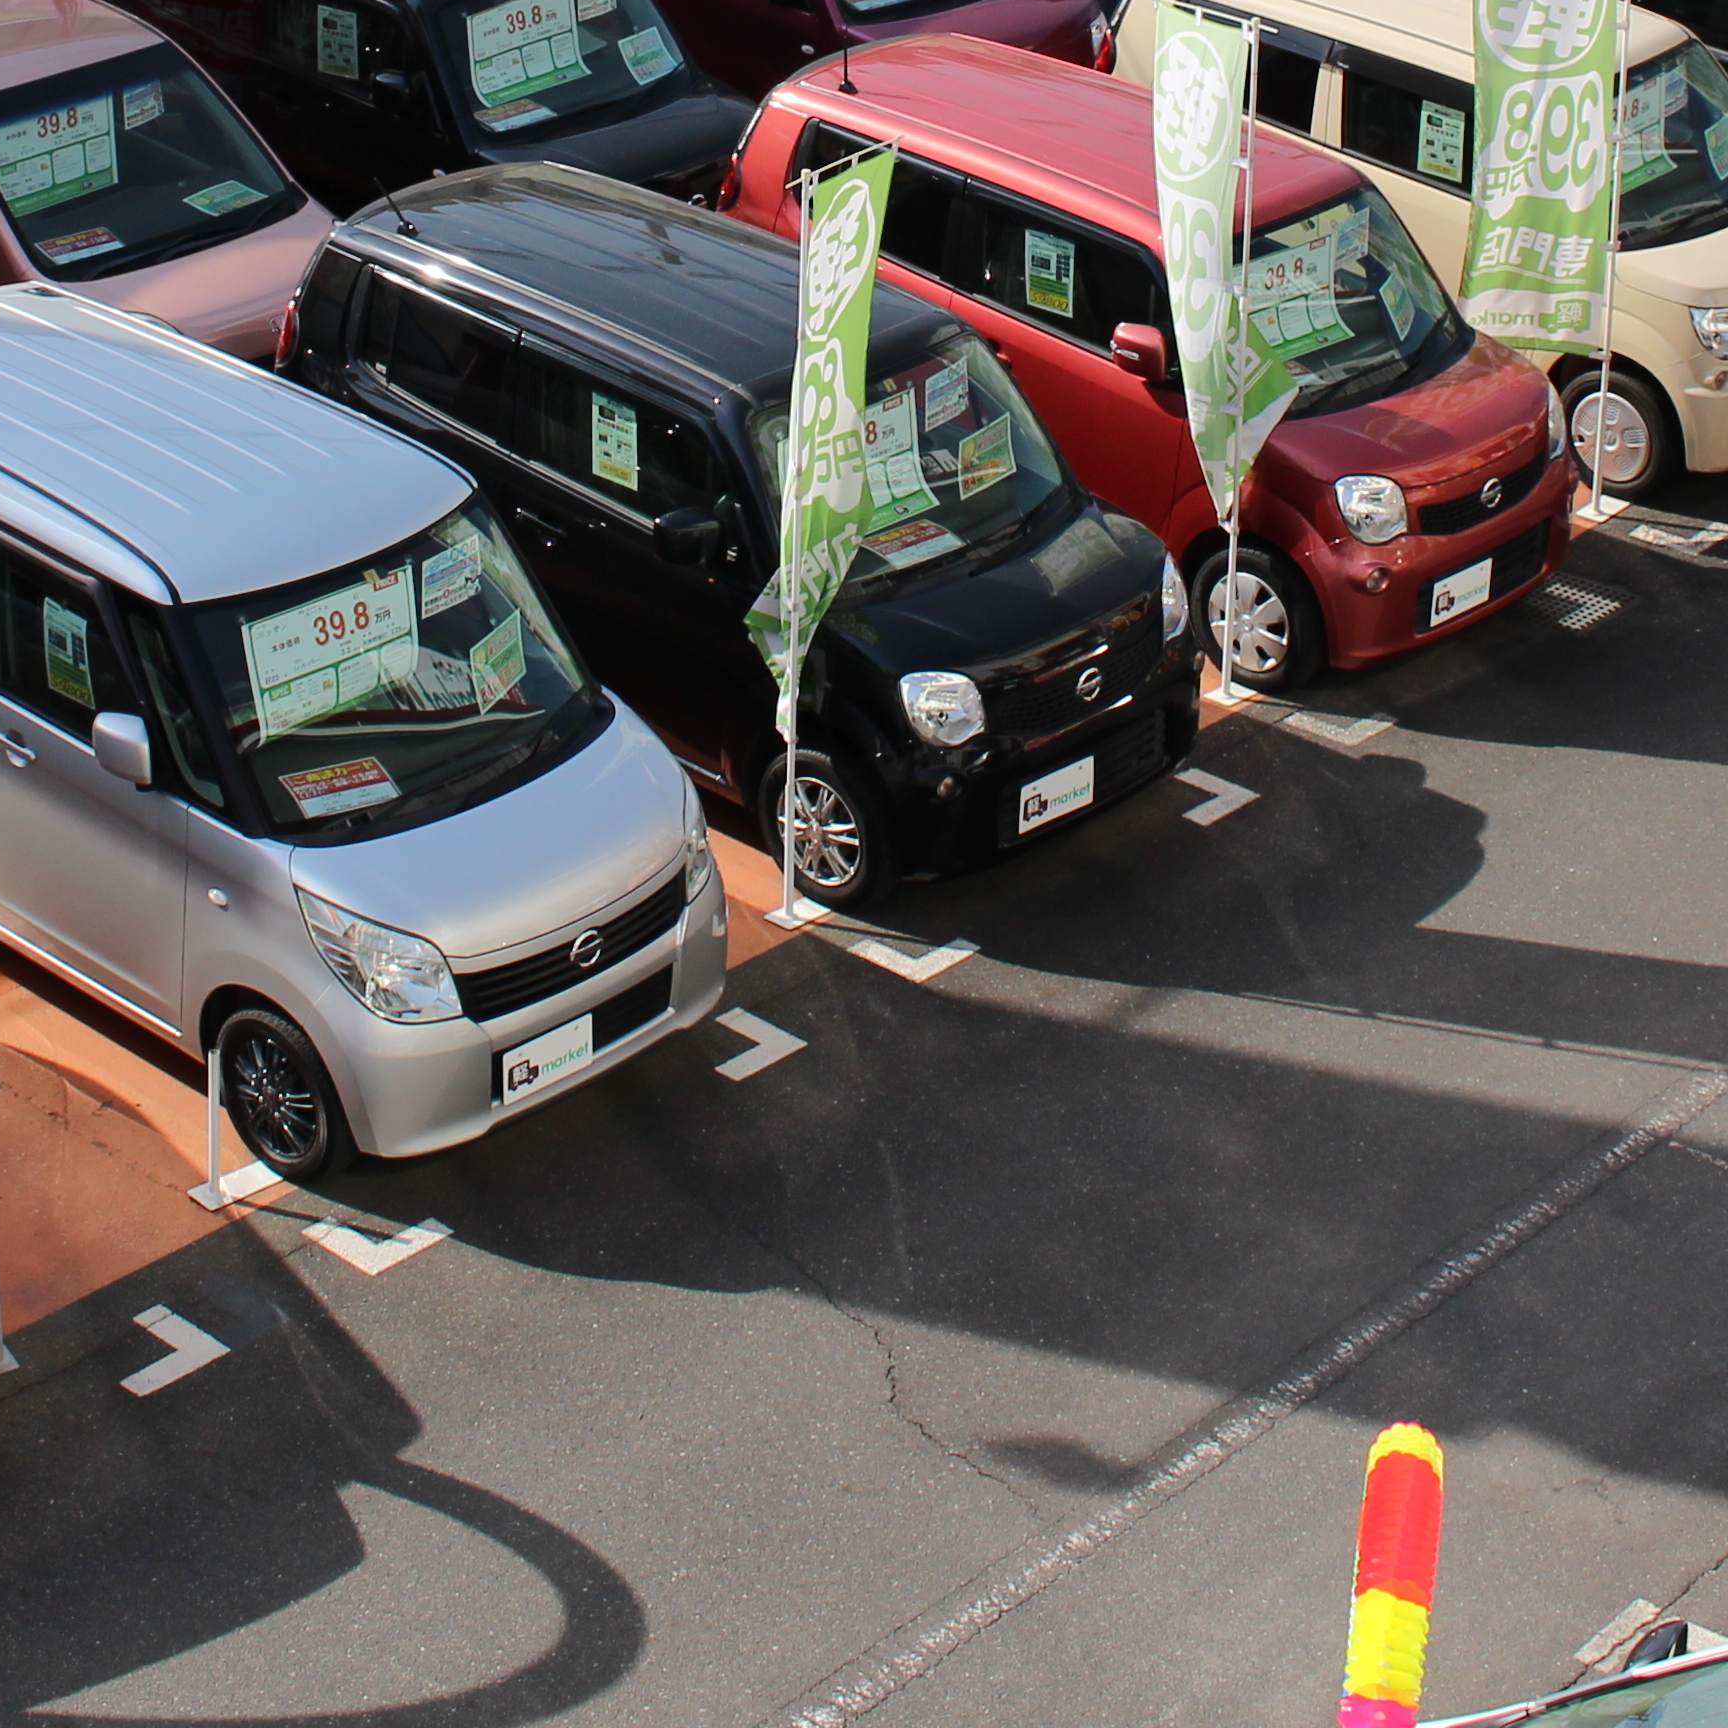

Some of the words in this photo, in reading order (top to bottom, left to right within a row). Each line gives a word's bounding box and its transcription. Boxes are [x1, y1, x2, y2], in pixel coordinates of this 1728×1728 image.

[506, 4, 543, 36] 39.8
[37, 106, 79, 139] 39.8
[805, 185, 869, 340] 軽
[1264, 256, 1305, 291] 39.8
[375, 574, 398, 590] PRICE
[1455, 585, 1489, 605] market
[271, 635, 303, 654] 本体価格
[313, 601, 371, 647] 39.8
[375, 609, 392, 625] 万円
[1048, 781, 1091, 810] market
[539, 1040, 593, 1079] market
